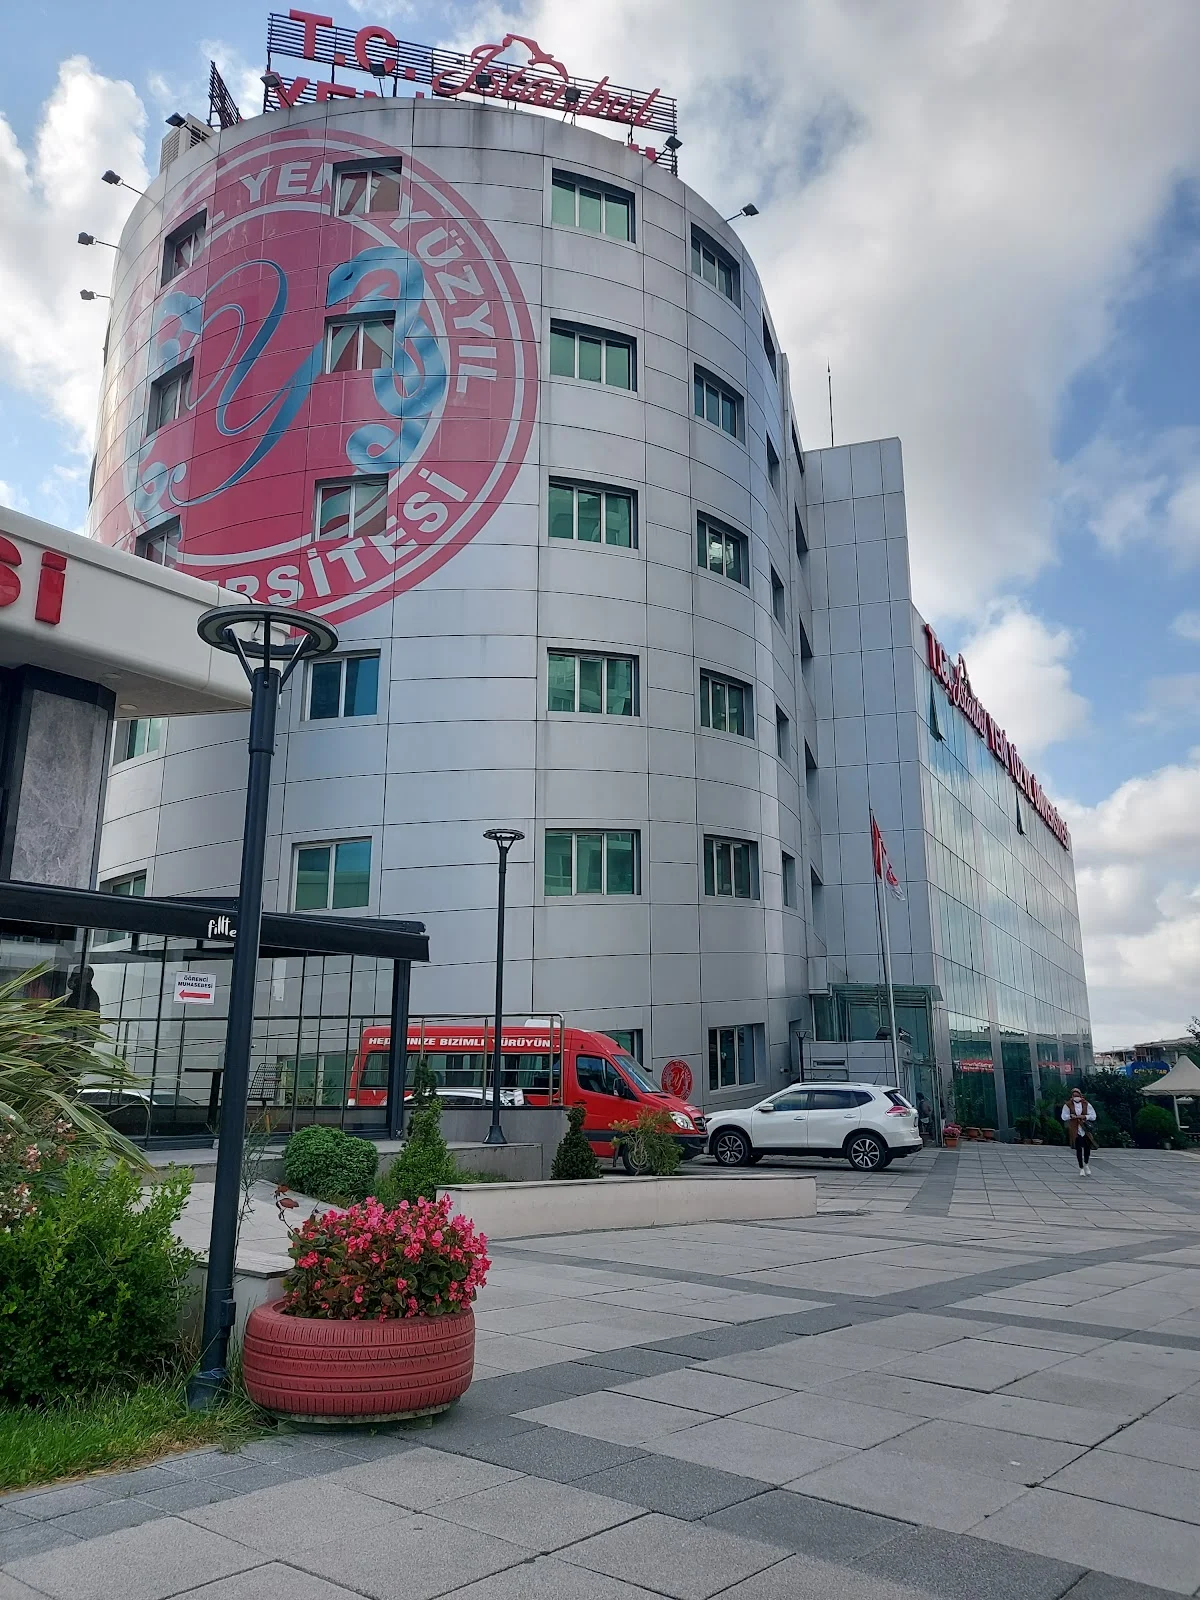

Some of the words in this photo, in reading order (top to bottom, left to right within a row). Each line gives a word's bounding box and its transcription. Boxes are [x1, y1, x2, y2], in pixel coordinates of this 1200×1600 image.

[289, 8, 417, 81] T.C.
[391, 191, 498, 394] YÜZYIL
[177, 981, 213, 989] MUHASEBESİ
